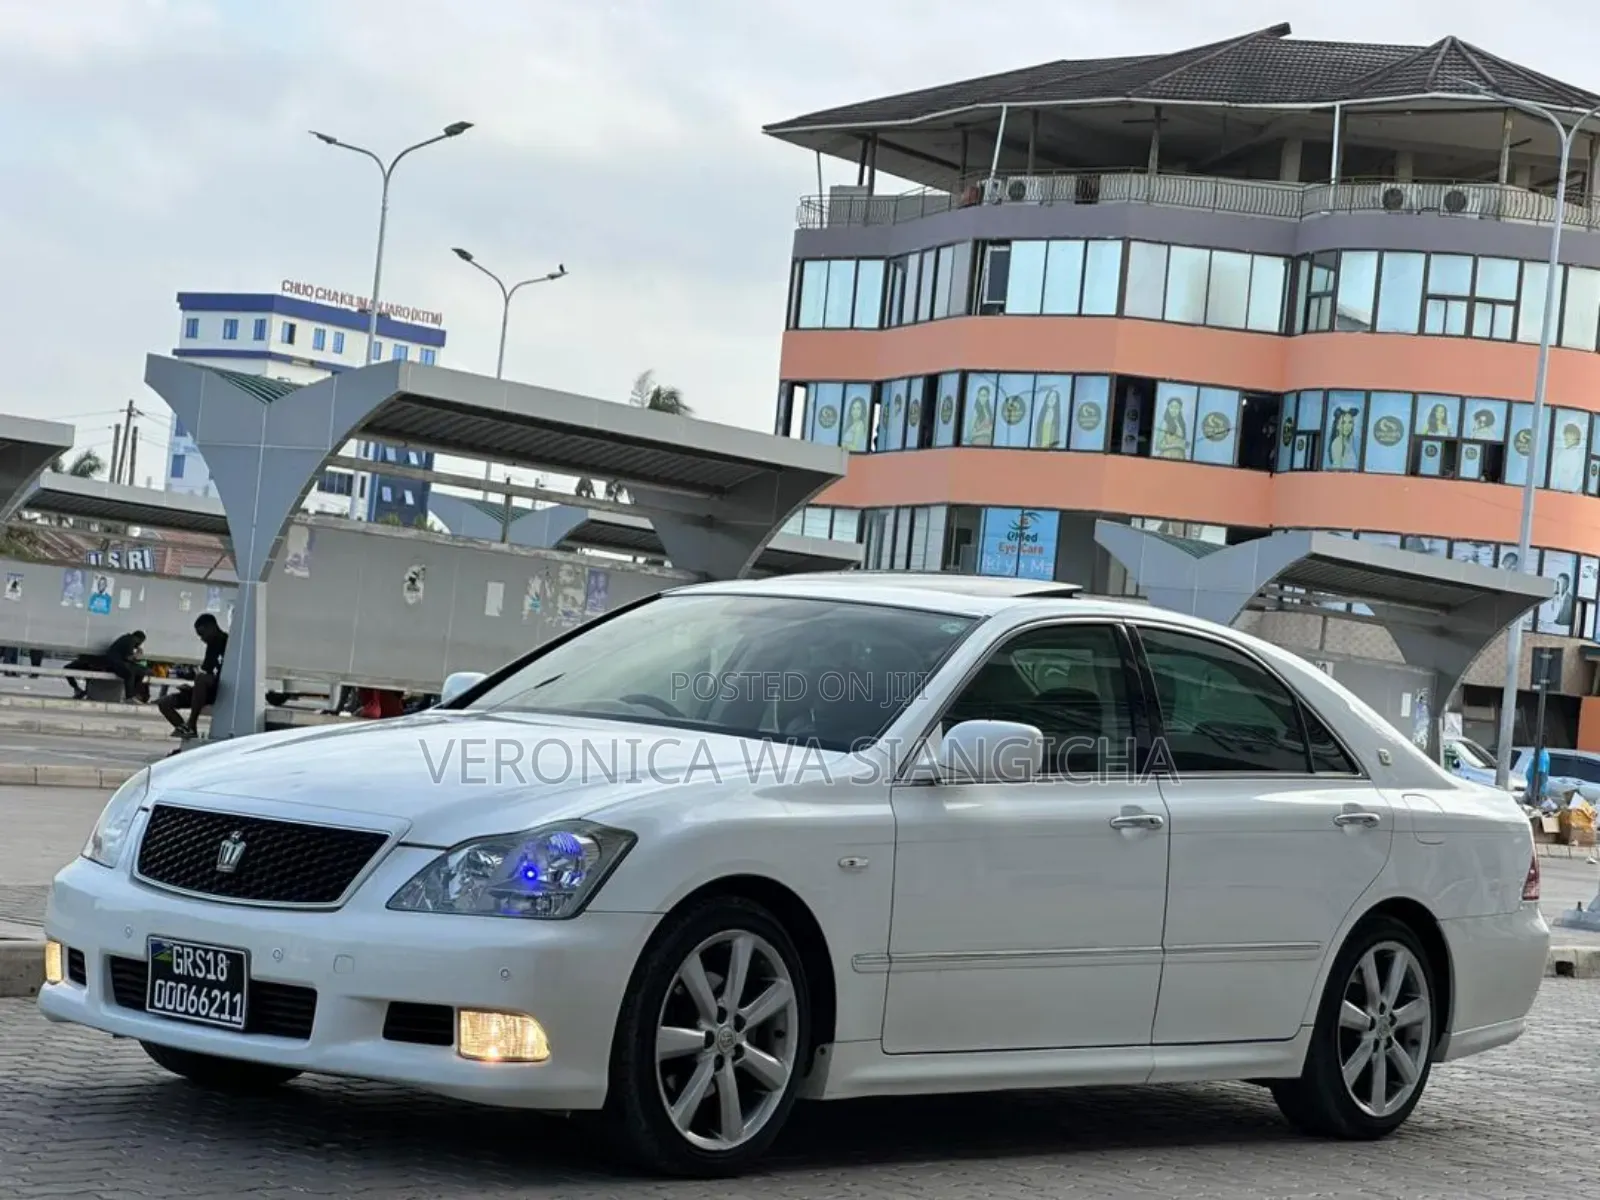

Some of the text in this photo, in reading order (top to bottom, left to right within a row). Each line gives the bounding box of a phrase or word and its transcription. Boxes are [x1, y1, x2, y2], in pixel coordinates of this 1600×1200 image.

[282, 279, 314, 297] CHUO
[315, 287, 339, 305] CHA
[172, 946, 228, 981] GRS18
[154, 979, 243, 1022] 00066211
